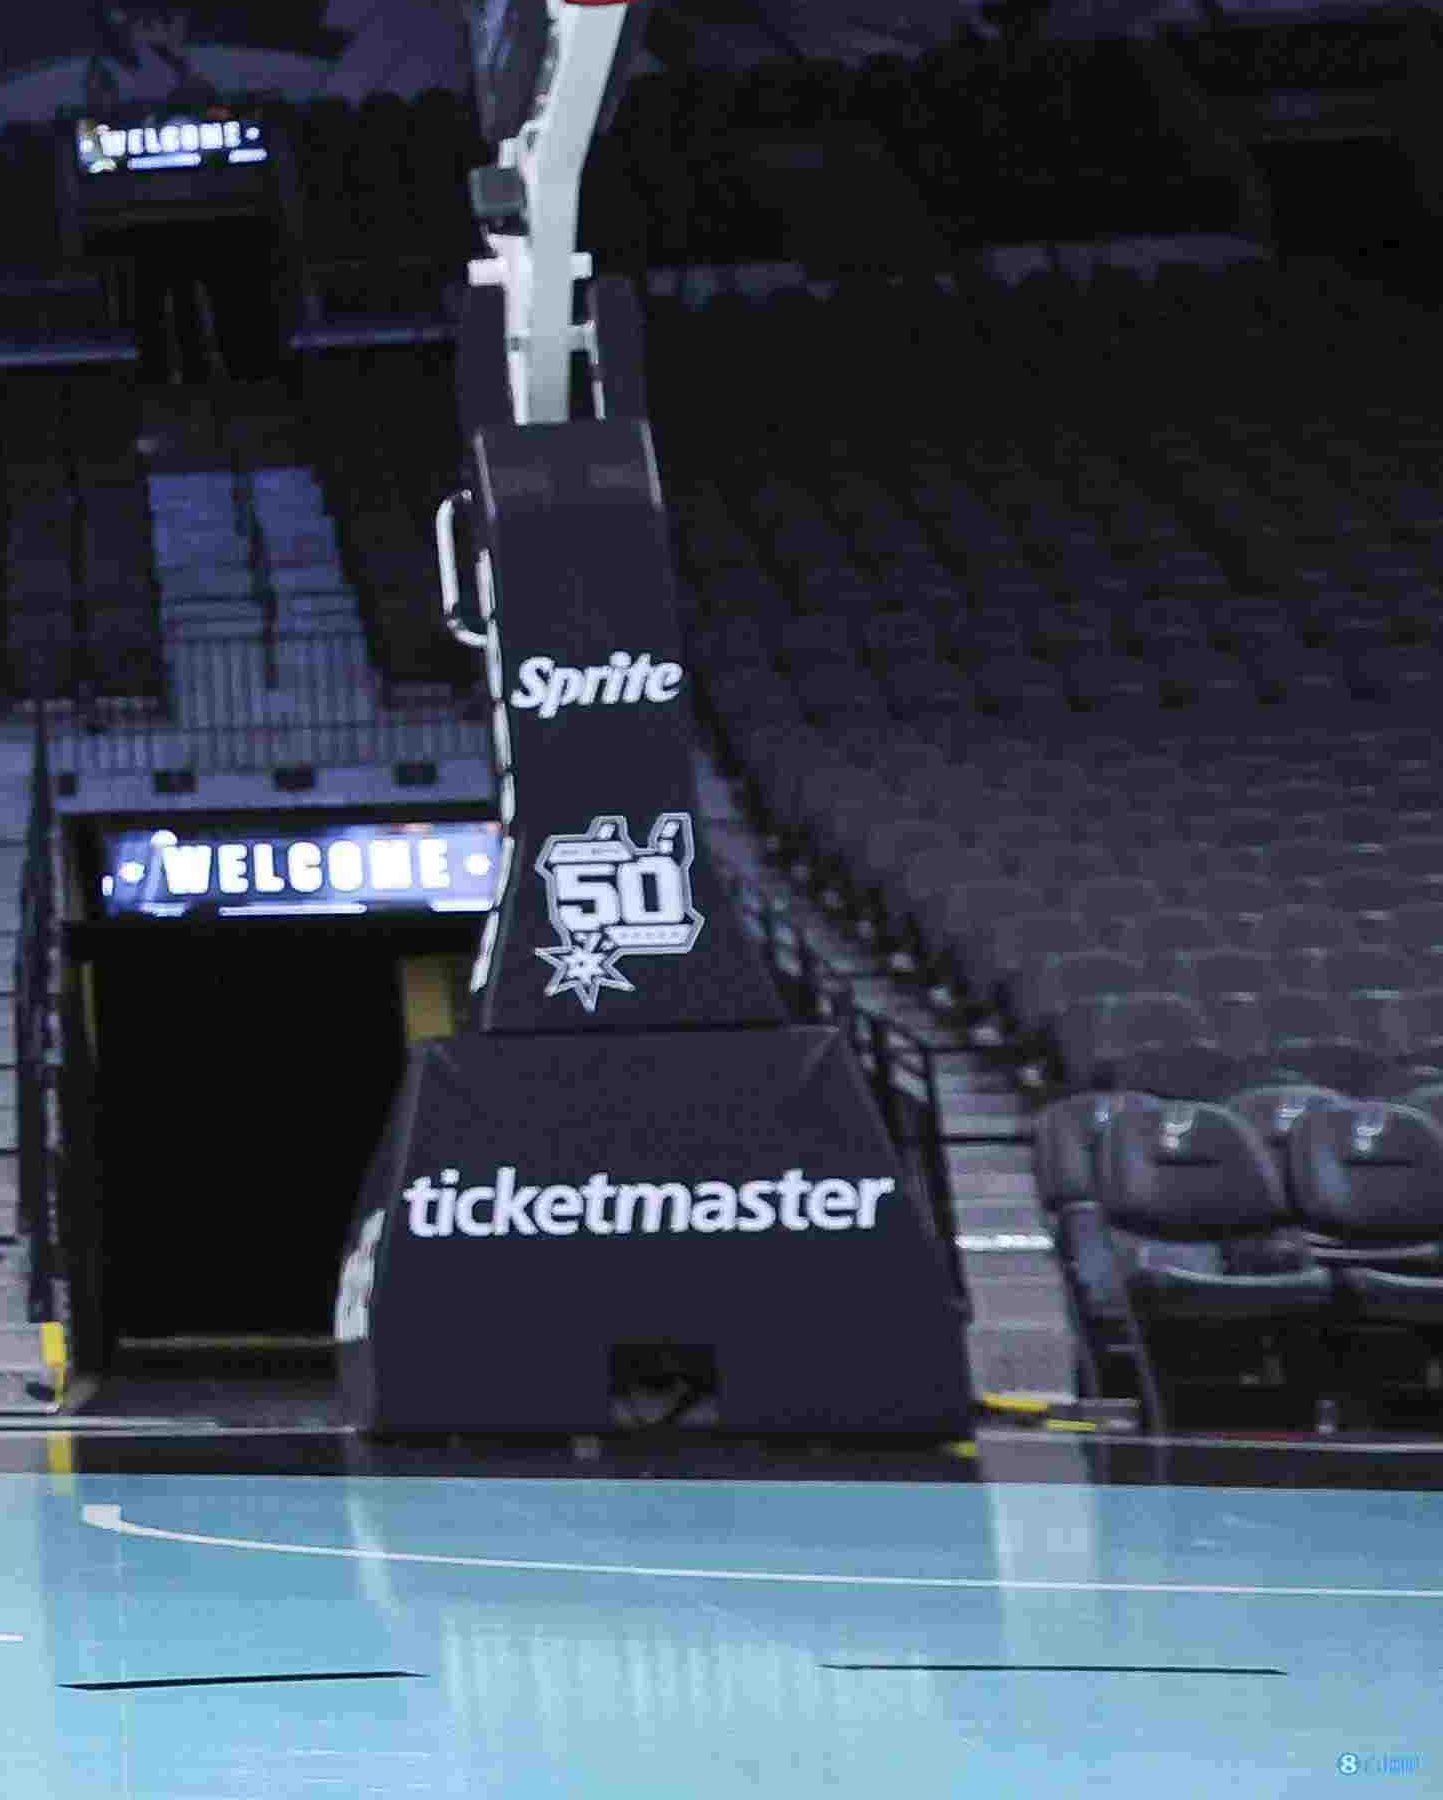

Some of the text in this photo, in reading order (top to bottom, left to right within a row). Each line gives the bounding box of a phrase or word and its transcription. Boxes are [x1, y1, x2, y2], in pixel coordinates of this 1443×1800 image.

[97, 120, 241, 157] WELCOME
[511, 651, 684, 718] Sprite
[159, 837, 452, 896] WELCOME
[552, 855, 685, 934] 50
[403, 1166, 896, 1239] ticketmaster
